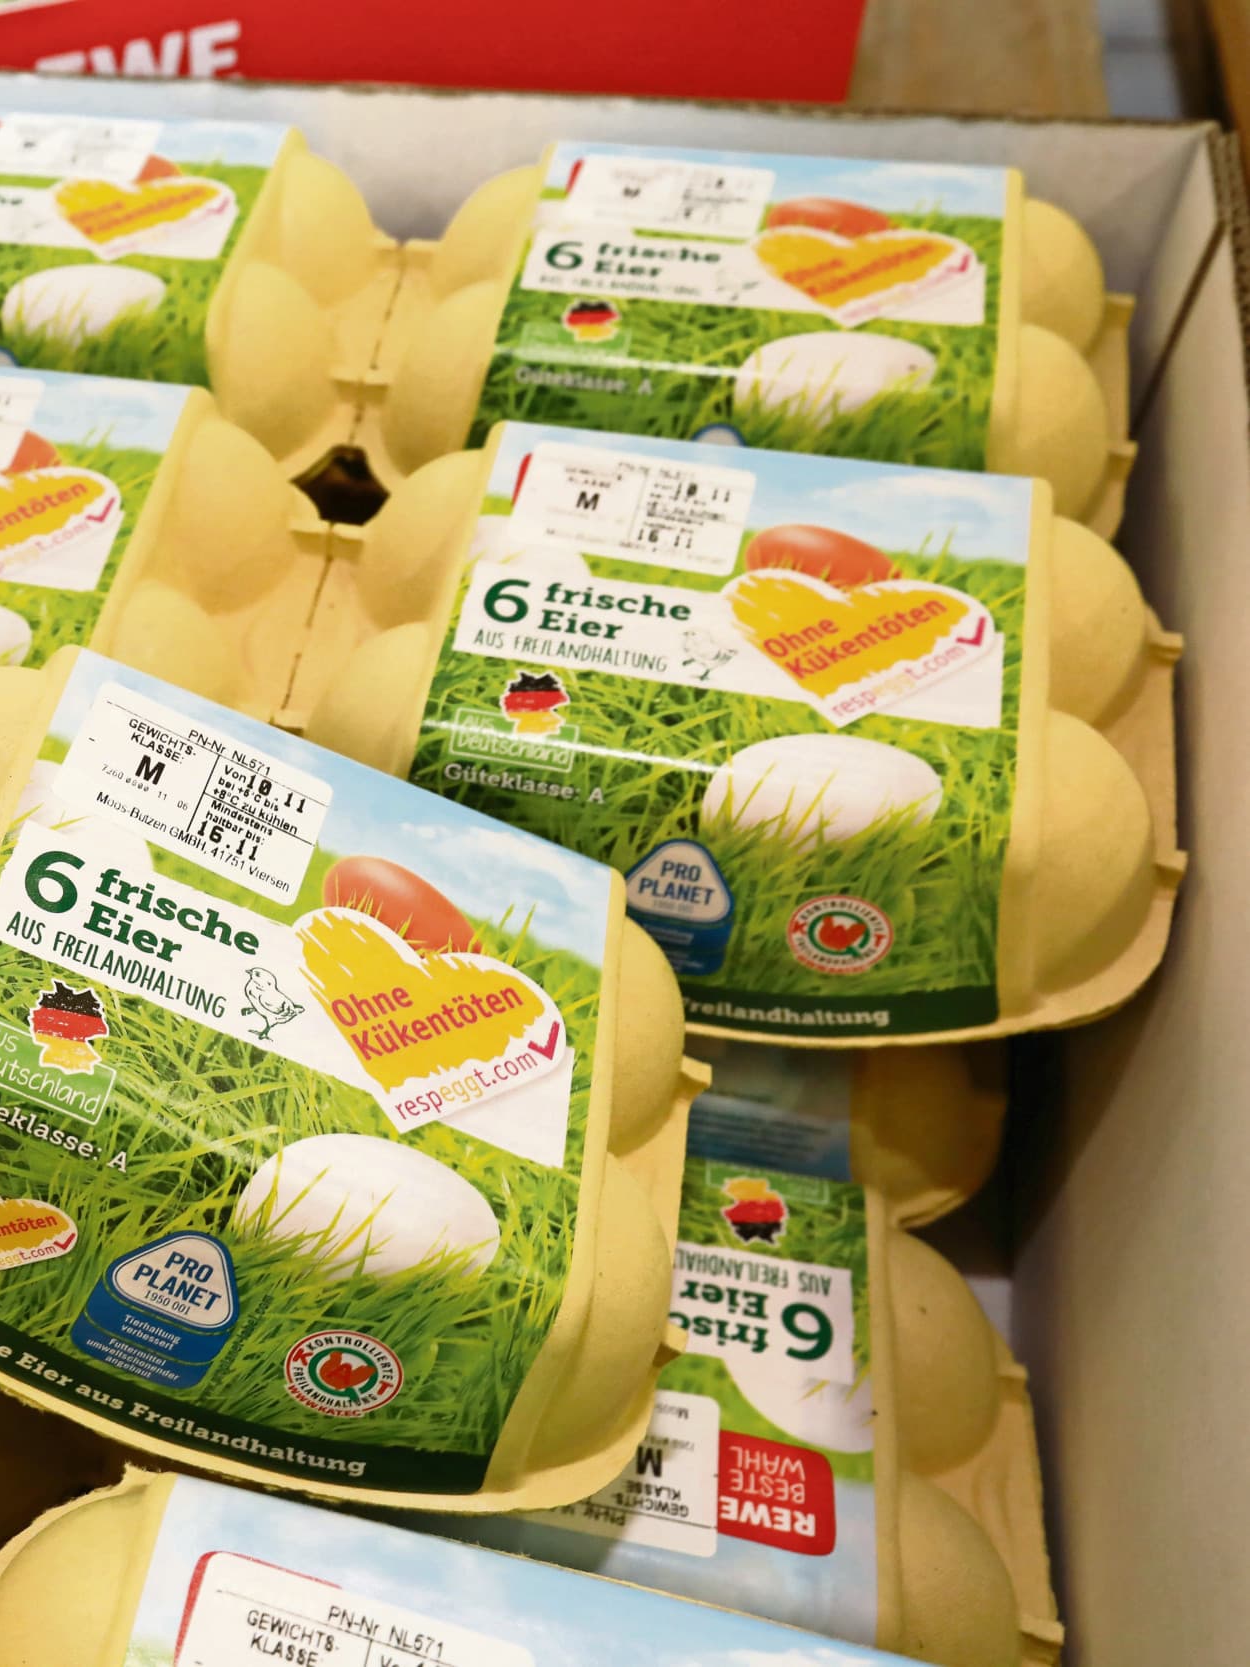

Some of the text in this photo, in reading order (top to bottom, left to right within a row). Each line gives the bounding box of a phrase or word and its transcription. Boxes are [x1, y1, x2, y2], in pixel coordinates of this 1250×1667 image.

[545, 241, 584, 270] 6
[575, 491, 600, 511] M
[483, 579, 692, 623] 6 frische
[538, 609, 623, 640] Eier
[763, 618, 839, 659] Ohne
[784, 600, 948, 680] Kükentöten
[474, 629, 668, 673] AUS FREILANDHALTUNG
[130, 733, 185, 765] KLASSE:
[135, 754, 166, 785] M
[188, 729, 271, 775] PN-Nr NL571
[224, 764, 306, 814] Von 10.11
[443, 763, 605, 804] Güteklasse: A
[206, 811, 244, 835] haltbar
[211, 800, 273, 836] Mindestens
[241, 803, 256, 815] zu
[197, 820, 259, 861] 16.11
[210, 846, 245, 871] 41751
[638, 877, 716, 906] PLANET
[660, 860, 702, 883] PRO
[24, 850, 261, 956] 6 frische
[83, 900, 183, 963] Eier
[5, 911, 227, 1019] AUS FREILANDHALTUNG
[331, 986, 414, 1028] Ohne
[350, 986, 524, 1062] Kükentöten
[394, 1050, 539, 1121] respeggt.com
[107, 1151, 129, 1173] A
[132, 1264, 222, 1311] PLANET
[164, 1251, 214, 1283] PRO
[673, 1250, 832, 1297] AUS FREILANDHAL
[144, 1290, 191, 1315] 1950 001
[679, 1280, 768, 1320] Eier
[123, 1314, 182, 1345] Tierhaltung
[669, 1303, 833, 1362] 6 frisc
[306, 1335, 394, 1381] KONTROLLIERTE
[16, 1351, 72, 1387] Eier
[75, 1380, 124, 1410] aus
[128, 1400, 367, 1478] Freilandhaltung
[636, 1447, 662, 1478] M
[729, 1445, 806, 1481] WAHL
[730, 1469, 807, 1504] BESTE
[719, 1495, 816, 1538] REWE
[247, 1609, 339, 1652] GEWICHTS-
[328, 1605, 443, 1658] PN-Nr NL571
